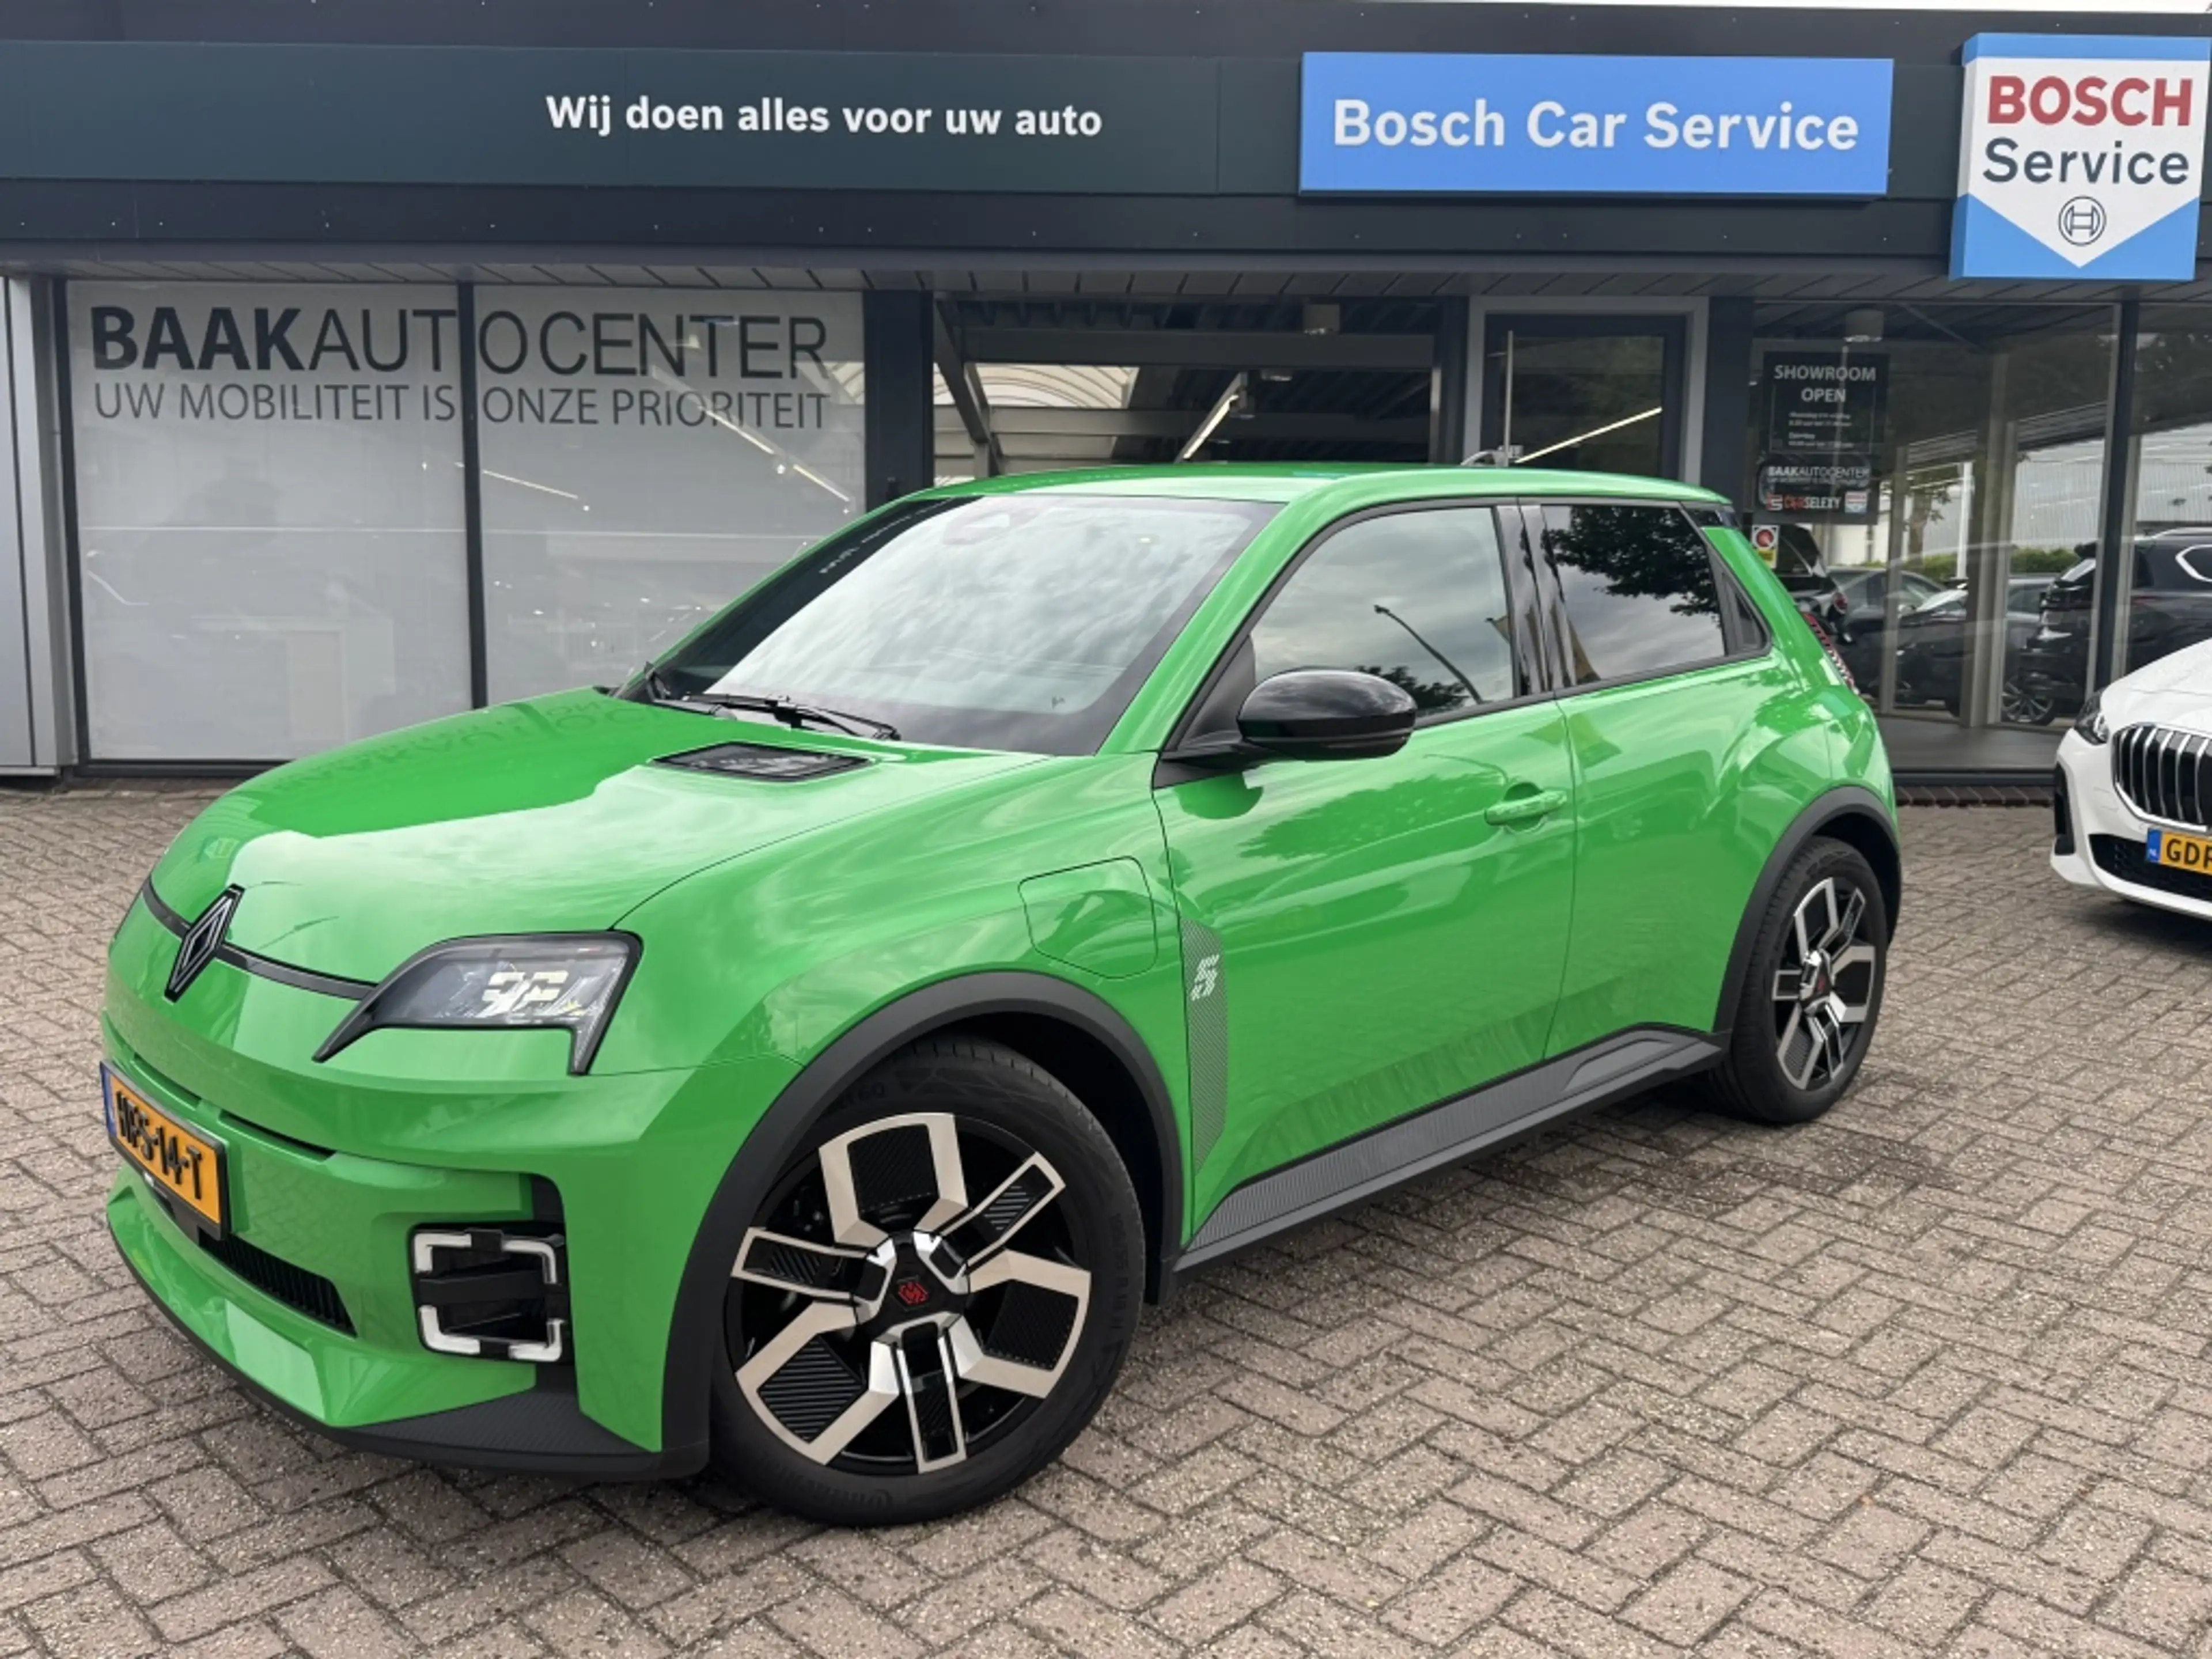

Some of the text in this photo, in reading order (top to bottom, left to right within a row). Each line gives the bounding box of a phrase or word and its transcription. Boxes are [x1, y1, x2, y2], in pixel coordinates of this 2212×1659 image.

[546, 96, 1102, 137] Wij doen alles voor uw auto
[1333, 97, 1858, 151] Bosch Car Service
[1987, 75, 2192, 126] BOSCH
[1983, 137, 2189, 185] Service
[90, 306, 830, 379] BAAKAUTOCENTER
[1774, 365, 1876, 381] SHOWROOM
[1801, 388, 1846, 403] OPEN
[96, 382, 831, 429] UW MOBILITEIT IS ONZE PRIORITEIT
